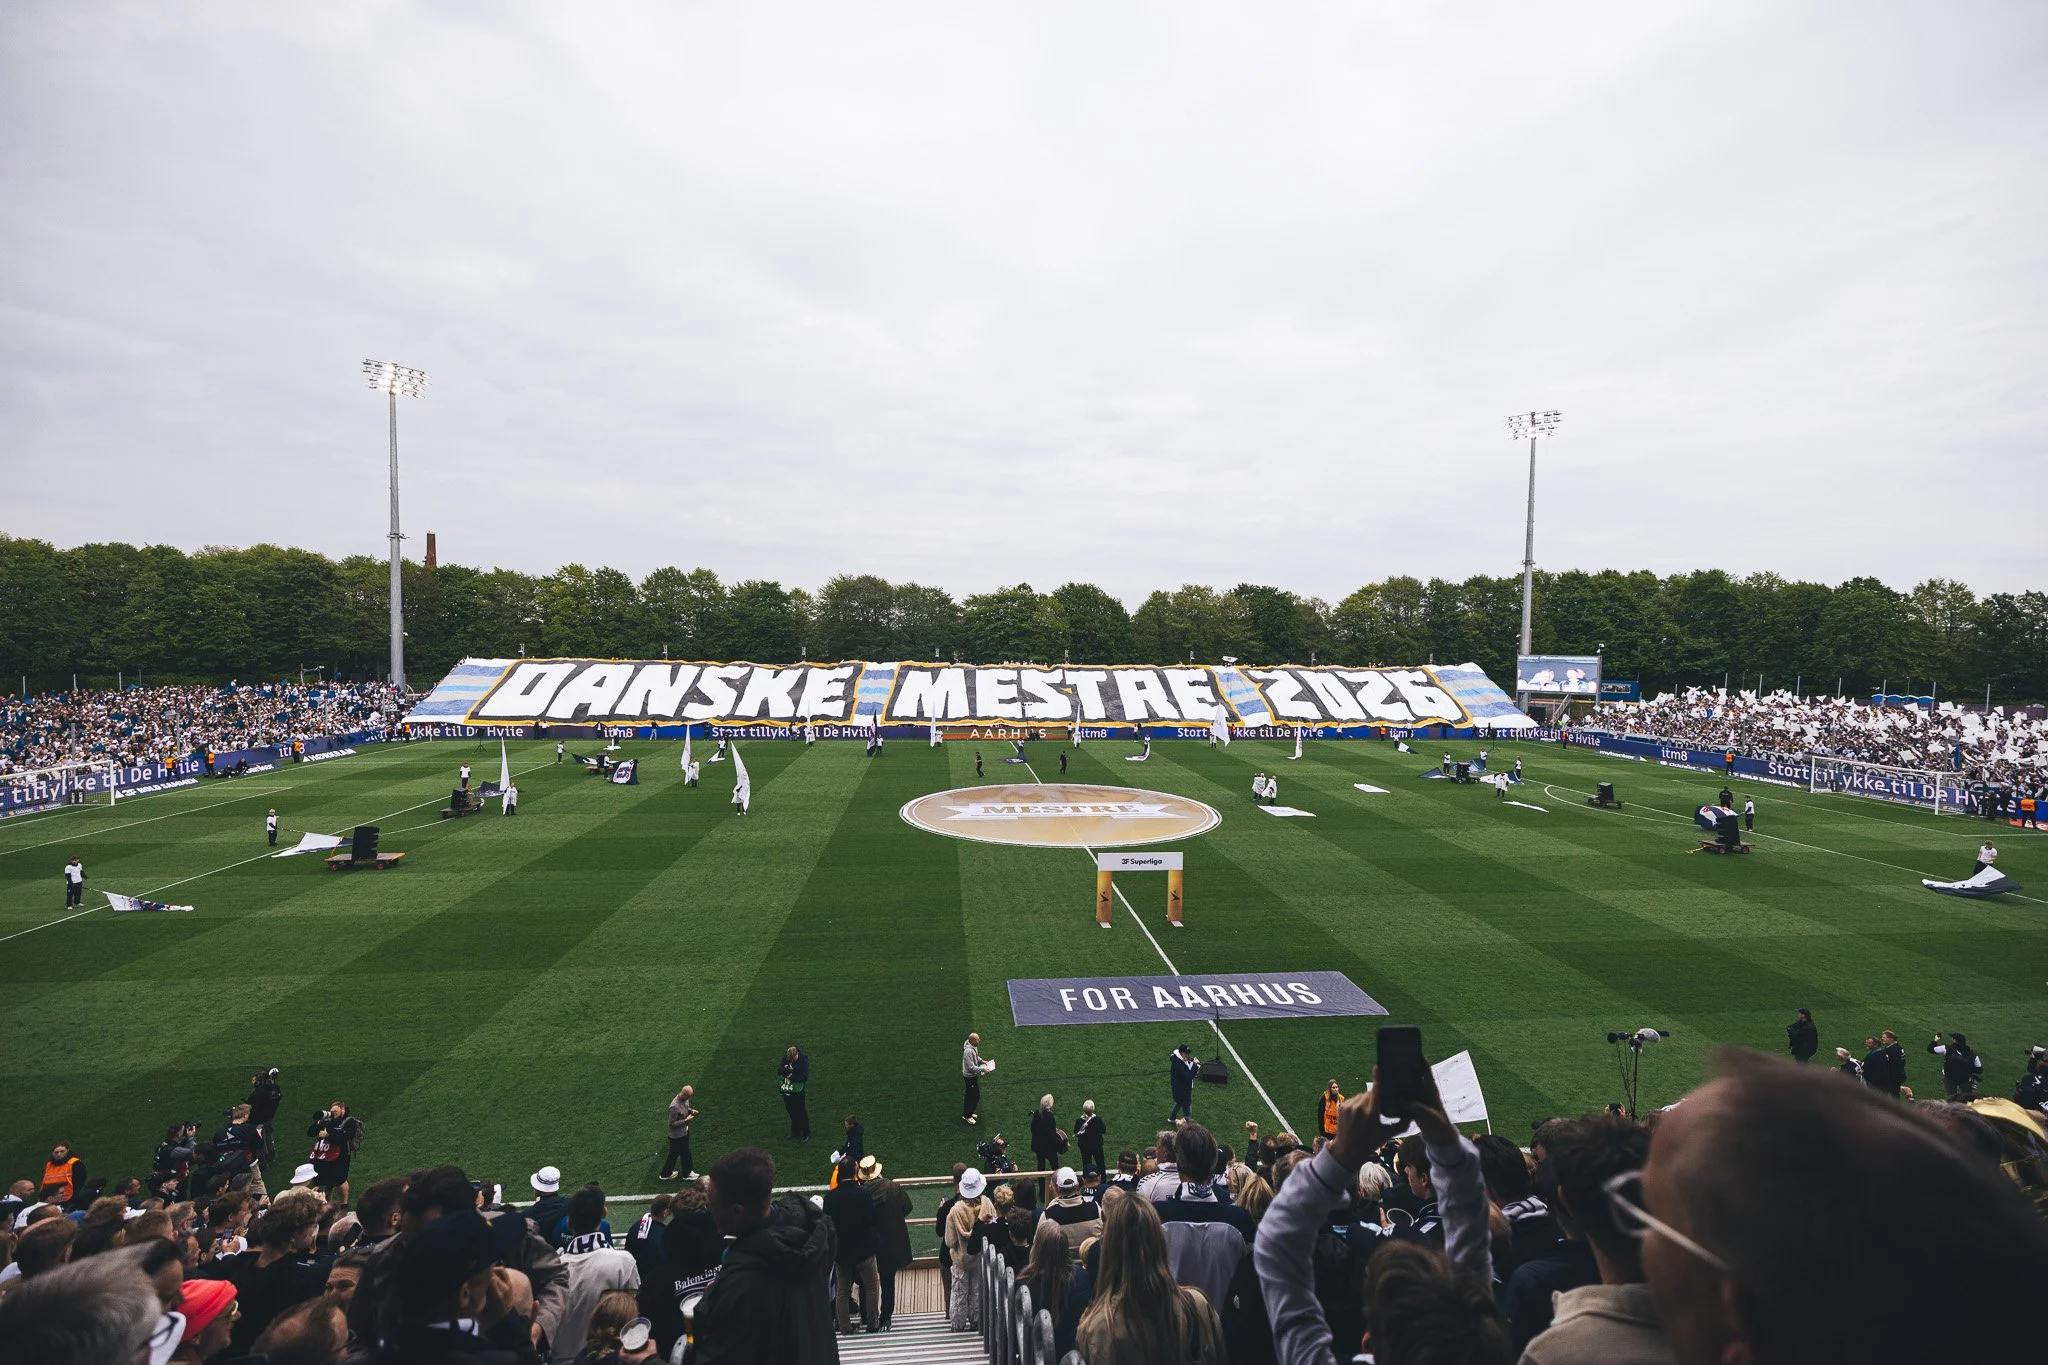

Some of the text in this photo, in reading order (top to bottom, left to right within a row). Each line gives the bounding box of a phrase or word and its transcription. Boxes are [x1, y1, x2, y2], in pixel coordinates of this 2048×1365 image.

[478, 663, 1463, 721] DANSKE MESTRE 2026
[446, 726, 462, 737] til
[487, 726, 524, 737] Hviie
[824, 727, 839, 737] De
[1080, 727, 1108, 738] itm8
[1177, 727, 1207, 738] Stort
[1259, 727, 1274, 737] til
[1276, 727, 1291, 738] De
[1575, 732, 1600, 746] Hviie
[1662, 747, 1688, 761] itm8
[131, 767, 152, 783] De
[1768, 762, 1809, 780] Stort
[1891, 780, 1917, 797] til
[138, 784, 161, 794] HOLD
[161, 778, 199, 789] SAMMEN
[981, 804, 1141, 814] MESTRE
[1121, 857, 1163, 867] 3F Superliga
[1059, 982, 1323, 1012] FOR AARHUS
